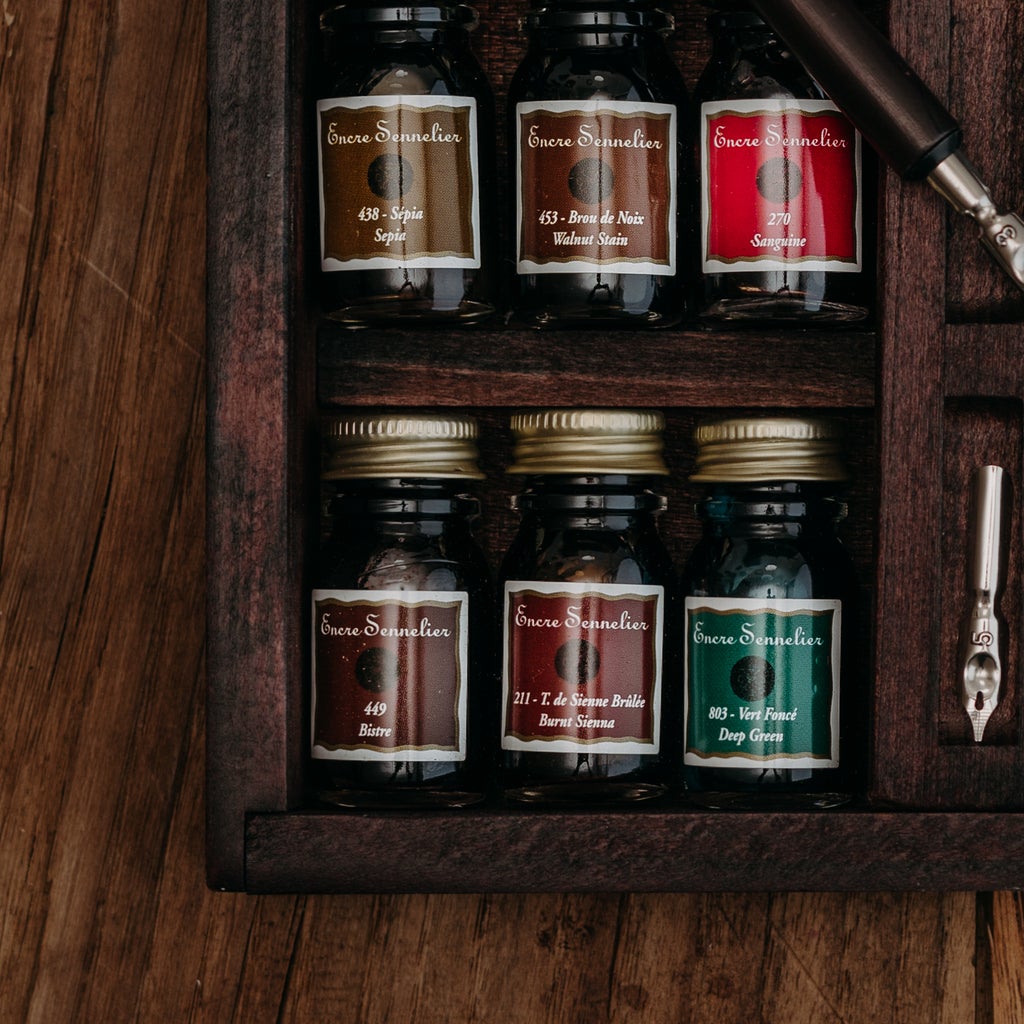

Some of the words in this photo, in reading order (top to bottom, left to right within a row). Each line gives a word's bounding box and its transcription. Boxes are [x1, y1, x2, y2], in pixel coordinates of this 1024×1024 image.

[327, 122, 373, 145] Encre
[375, 120, 462, 144] Sennelier
[528, 125, 575, 148] Encre
[577, 124, 662, 150] Sennelier
[713, 125, 763, 148] Encre
[765, 124, 847, 148] Sennelier
[358, 206, 379, 221] 438
[390, 206, 424, 224] Sépia
[539, 210, 558, 225] 453
[568, 210, 597, 224] Brou
[600, 210, 614, 224] de
[616, 210, 645, 225] Noix
[767, 212, 791, 226] 270
[374, 228, 407, 246] Sepia
[553, 231, 594, 246] Walnut
[597, 231, 628, 246] Stain
[751, 233, 807, 251] Sanguine
[320, 613, 362, 636] Encre
[364, 614, 451, 637] Sennelier
[515, 604, 561, 627] Encre
[565, 606, 649, 630] Sennelier
[693, 622, 737, 644] Encre
[739, 622, 824, 646] Sennelier
[364, 701, 387, 716] 449
[513, 692, 530, 705] 211
[541, 692, 551, 705] T.
[553, 692, 567, 706] de
[570, 693, 609, 708] Sienne
[611, 694, 646, 708] Brûlée
[539, 713, 573, 727] Burnt
[575, 714, 615, 729] Sienna
[709, 706, 728, 720] 803
[739, 706, 762, 720] Vert
[764, 707, 798, 721] Foncé
[358, 723, 392, 737] Bistre
[719, 727, 746, 746] Deep
[749, 728, 784, 742] Green
